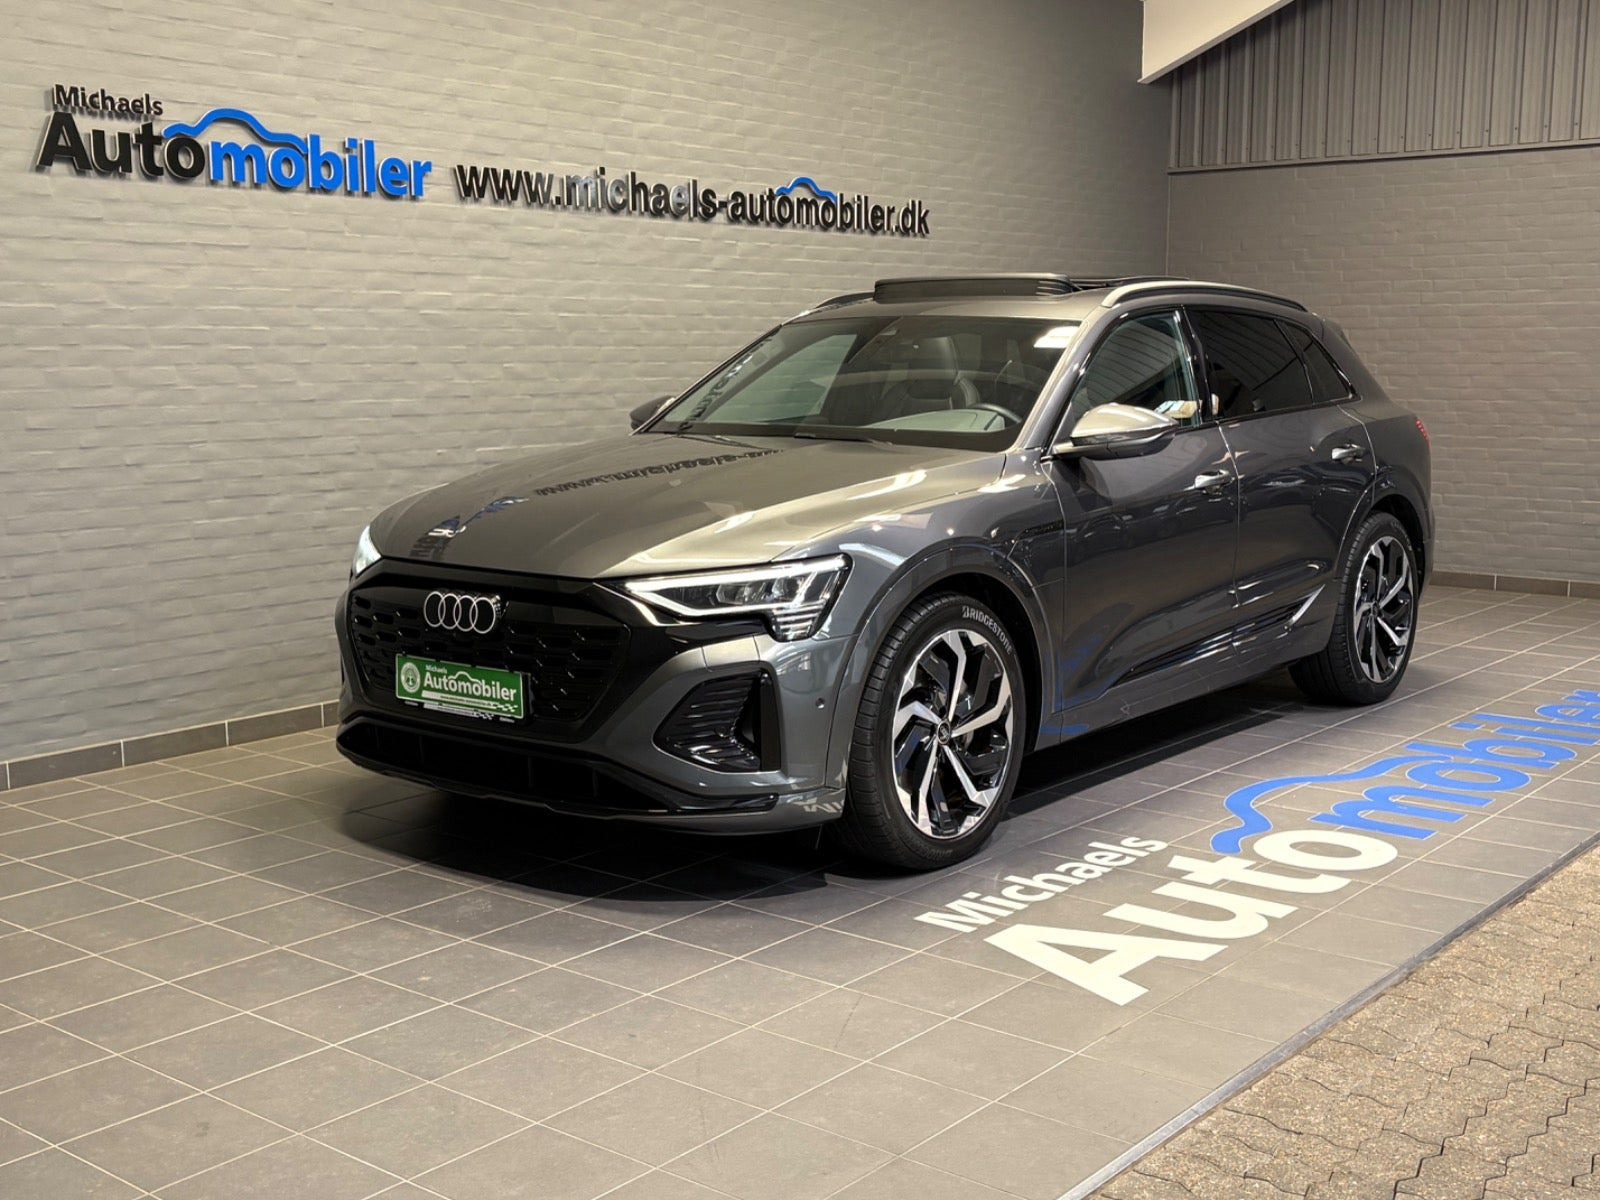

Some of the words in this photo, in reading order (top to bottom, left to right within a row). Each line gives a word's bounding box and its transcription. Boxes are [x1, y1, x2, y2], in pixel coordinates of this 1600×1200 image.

[52, 83, 164, 116] Michaels
[36, 110, 432, 198] Automobiler
[454, 164, 930, 237] www.michaels-automobiler.dk
[961, 605, 1013, 655] BRIDGESTONE
[423, 671, 517, 702] Automobiler
[914, 831, 1169, 934] Michaels
